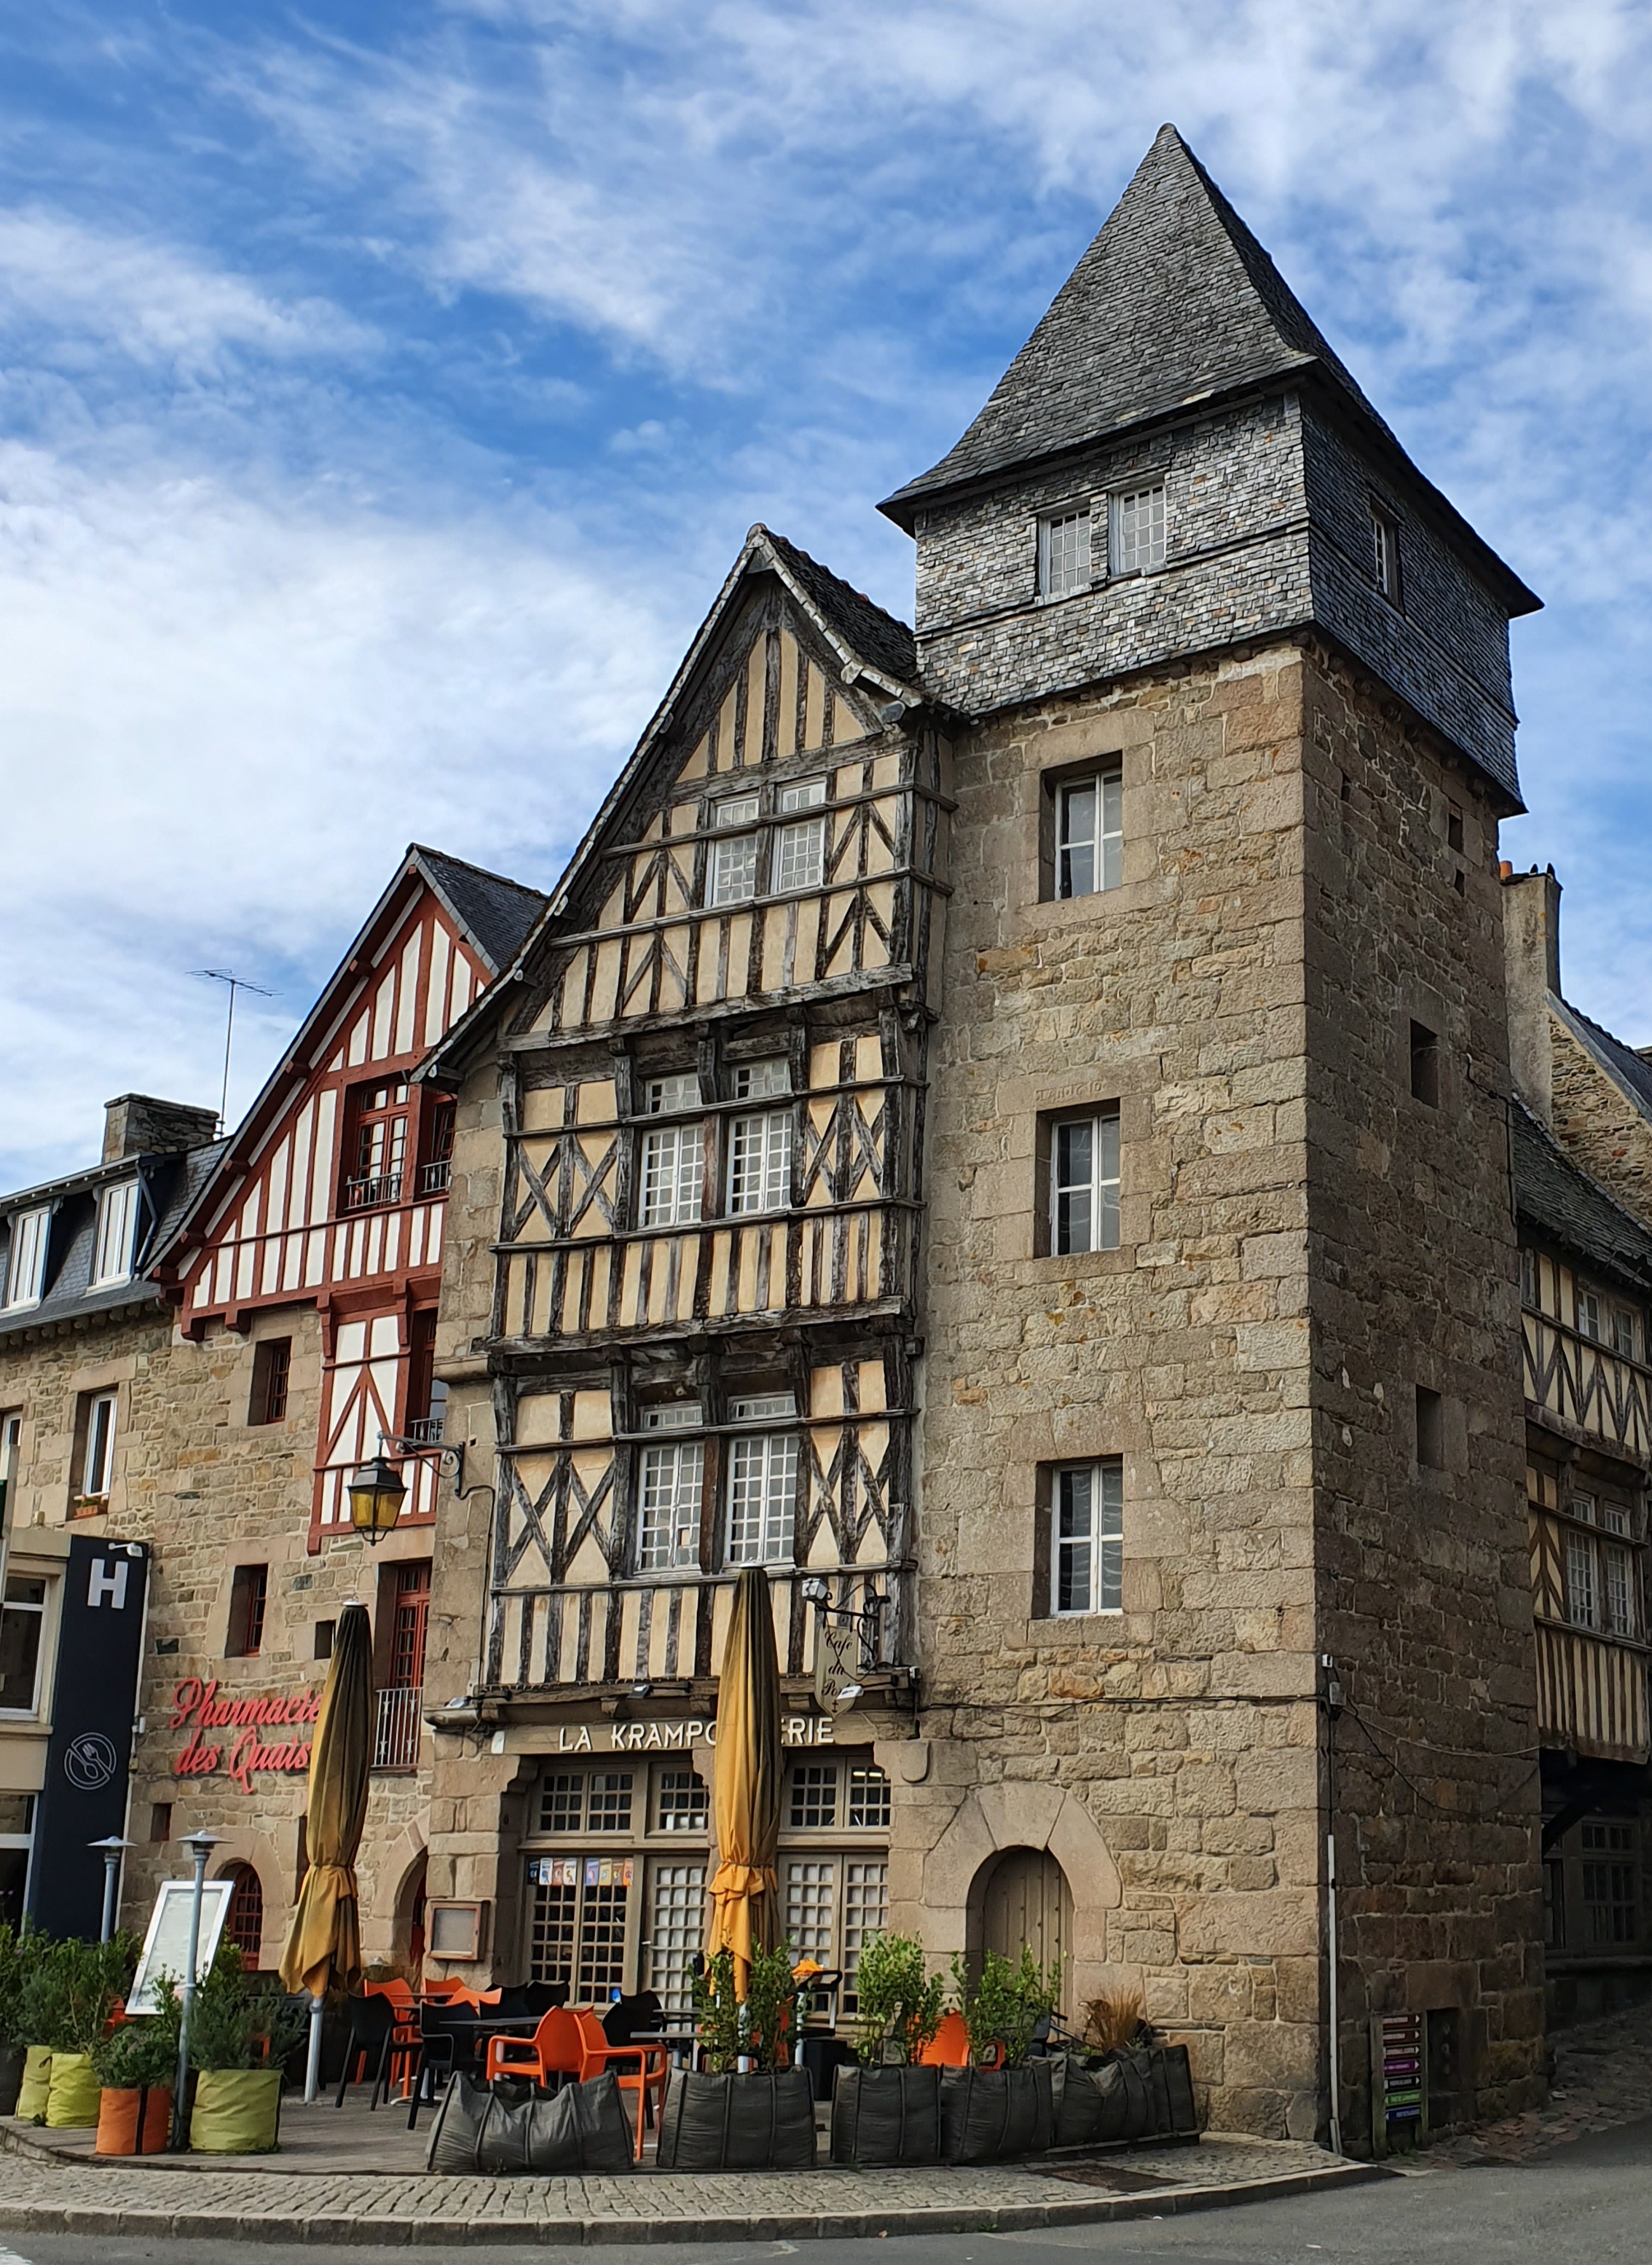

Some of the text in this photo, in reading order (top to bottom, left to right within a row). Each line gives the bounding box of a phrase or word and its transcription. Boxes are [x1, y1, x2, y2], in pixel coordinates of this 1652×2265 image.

[87, 1558, 128, 1609] H
[169, 1677, 323, 1729] Pharmacie
[175, 1725, 313, 1794] des Quais
[559, 1726, 592, 1751] LA
